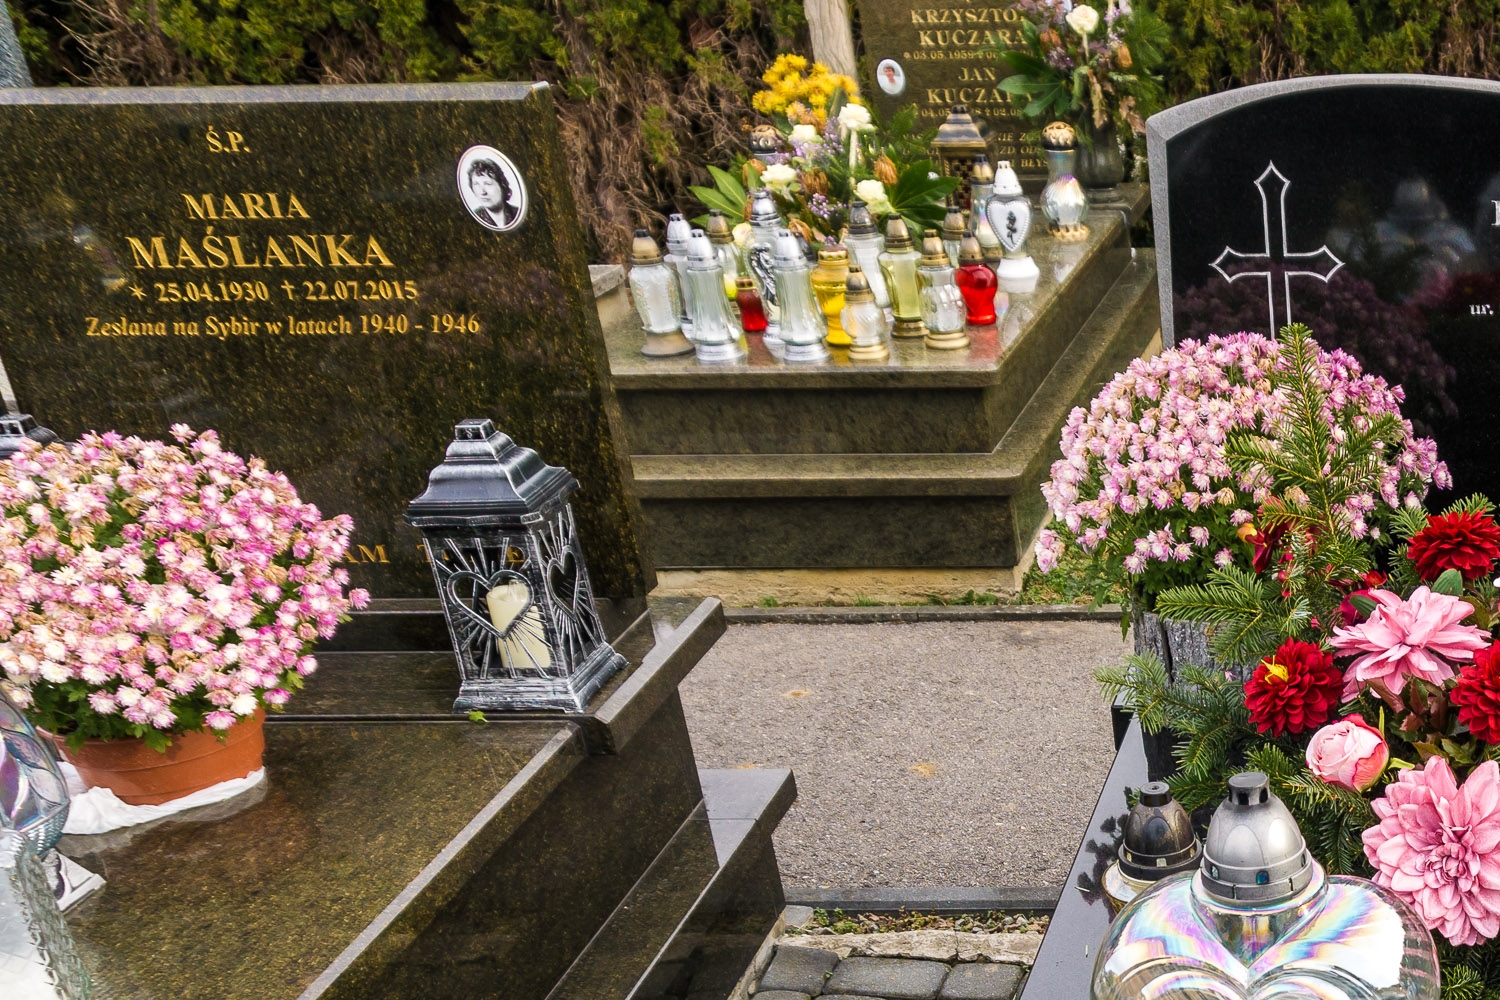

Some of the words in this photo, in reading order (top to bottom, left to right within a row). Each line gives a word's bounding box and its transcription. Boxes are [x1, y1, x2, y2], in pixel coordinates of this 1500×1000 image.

[911, 8, 1025, 23] KRZYSZTO
[919, 29, 1028, 46] KUCZARA
[958, 67, 996, 81] JAN
[927, 87, 1033, 103] KUCZA
[205, 125, 251, 153] Ś.P.
[181, 192, 311, 220] MARIA
[124, 225, 396, 269] MAŚLANKA
[153, 281, 270, 303] 25.04.1930
[305, 280, 419, 301] 22.07.2015
[1470, 303, 1494, 315] ur.
[173, 321, 200, 337] na
[205, 315, 262, 341] Sybir
[264, 321, 283, 335] w
[287, 315, 353, 335] latach
[360, 314, 407, 334] 1940
[431, 313, 480, 333] 1946
